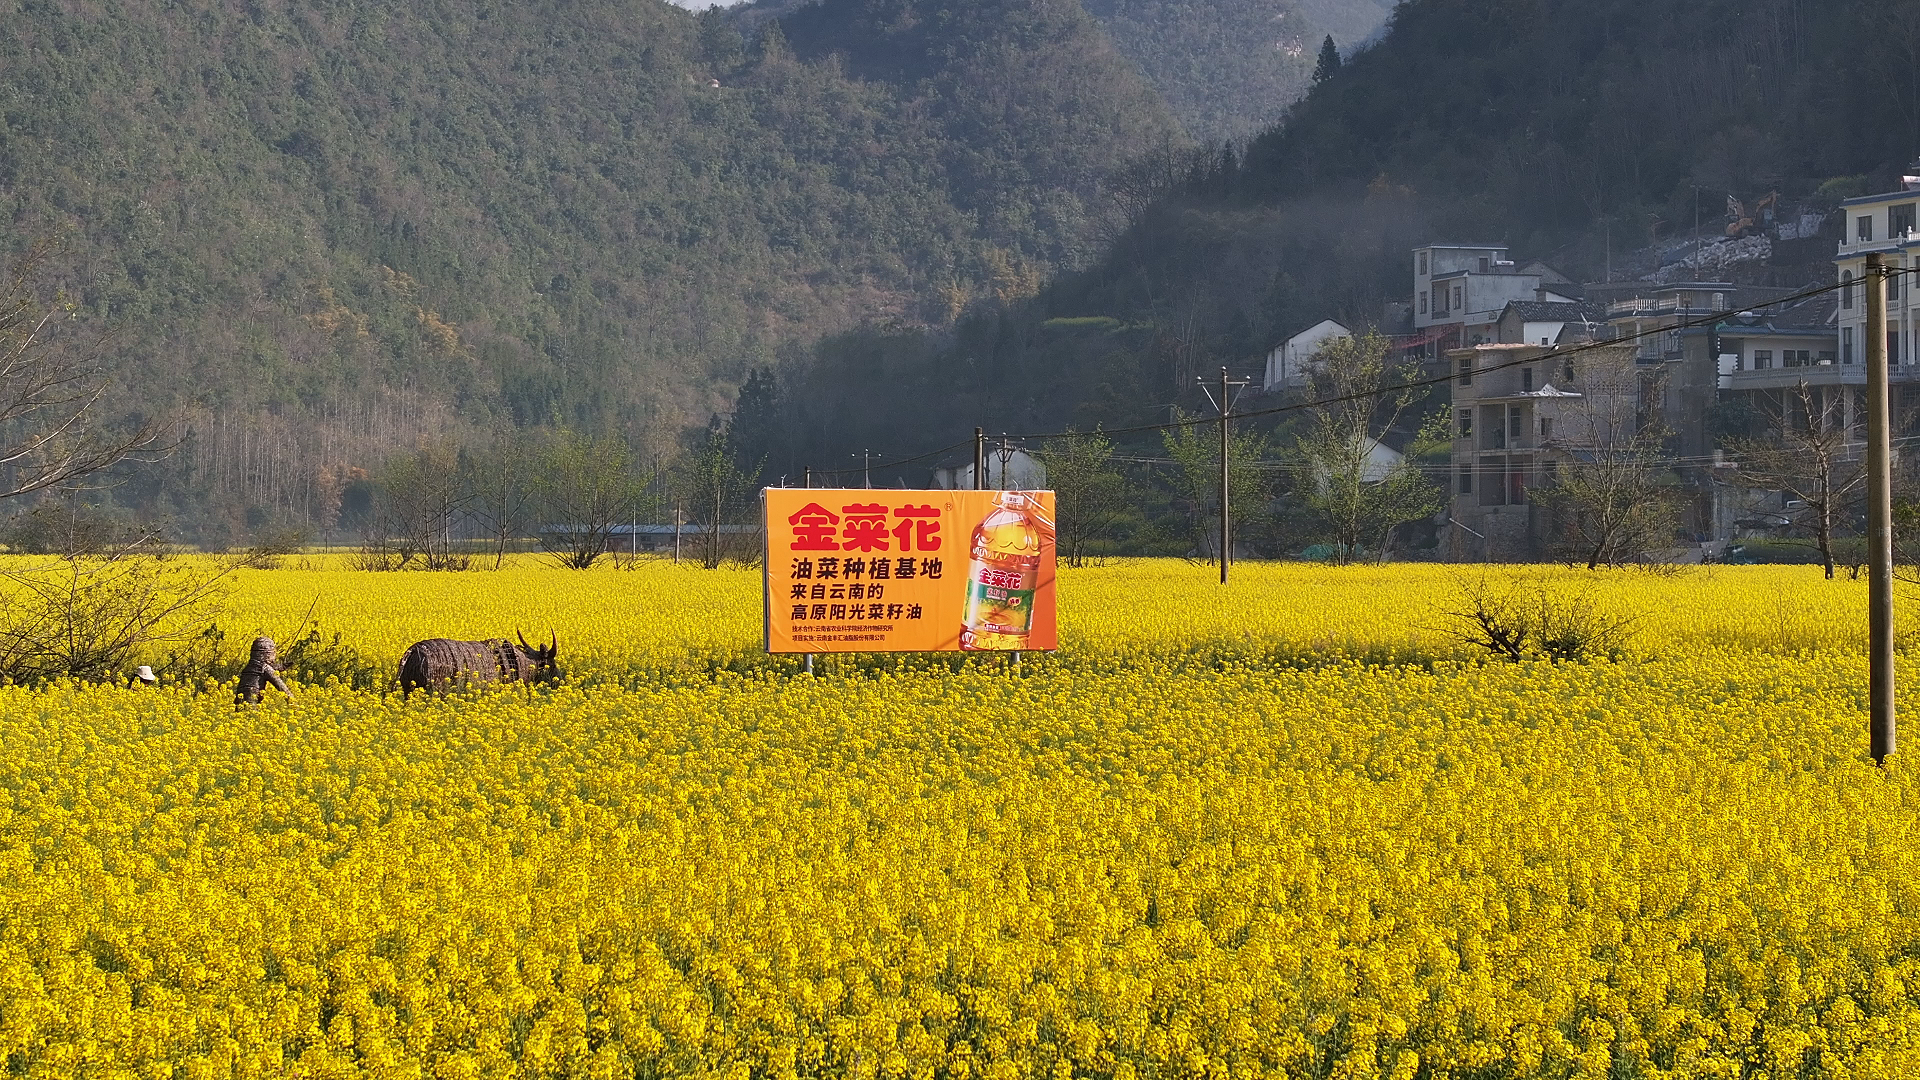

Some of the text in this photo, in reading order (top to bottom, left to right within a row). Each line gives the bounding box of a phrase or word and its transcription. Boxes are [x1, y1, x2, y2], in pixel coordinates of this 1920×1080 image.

[788, 502, 942, 552] 金菜花
[790, 557, 943, 580] 油菜种植基地
[979, 567, 1022, 589] 金菜花
[790, 583, 885, 600] 来自云南的
[791, 603, 923, 620] 高原阳光菜籽油
